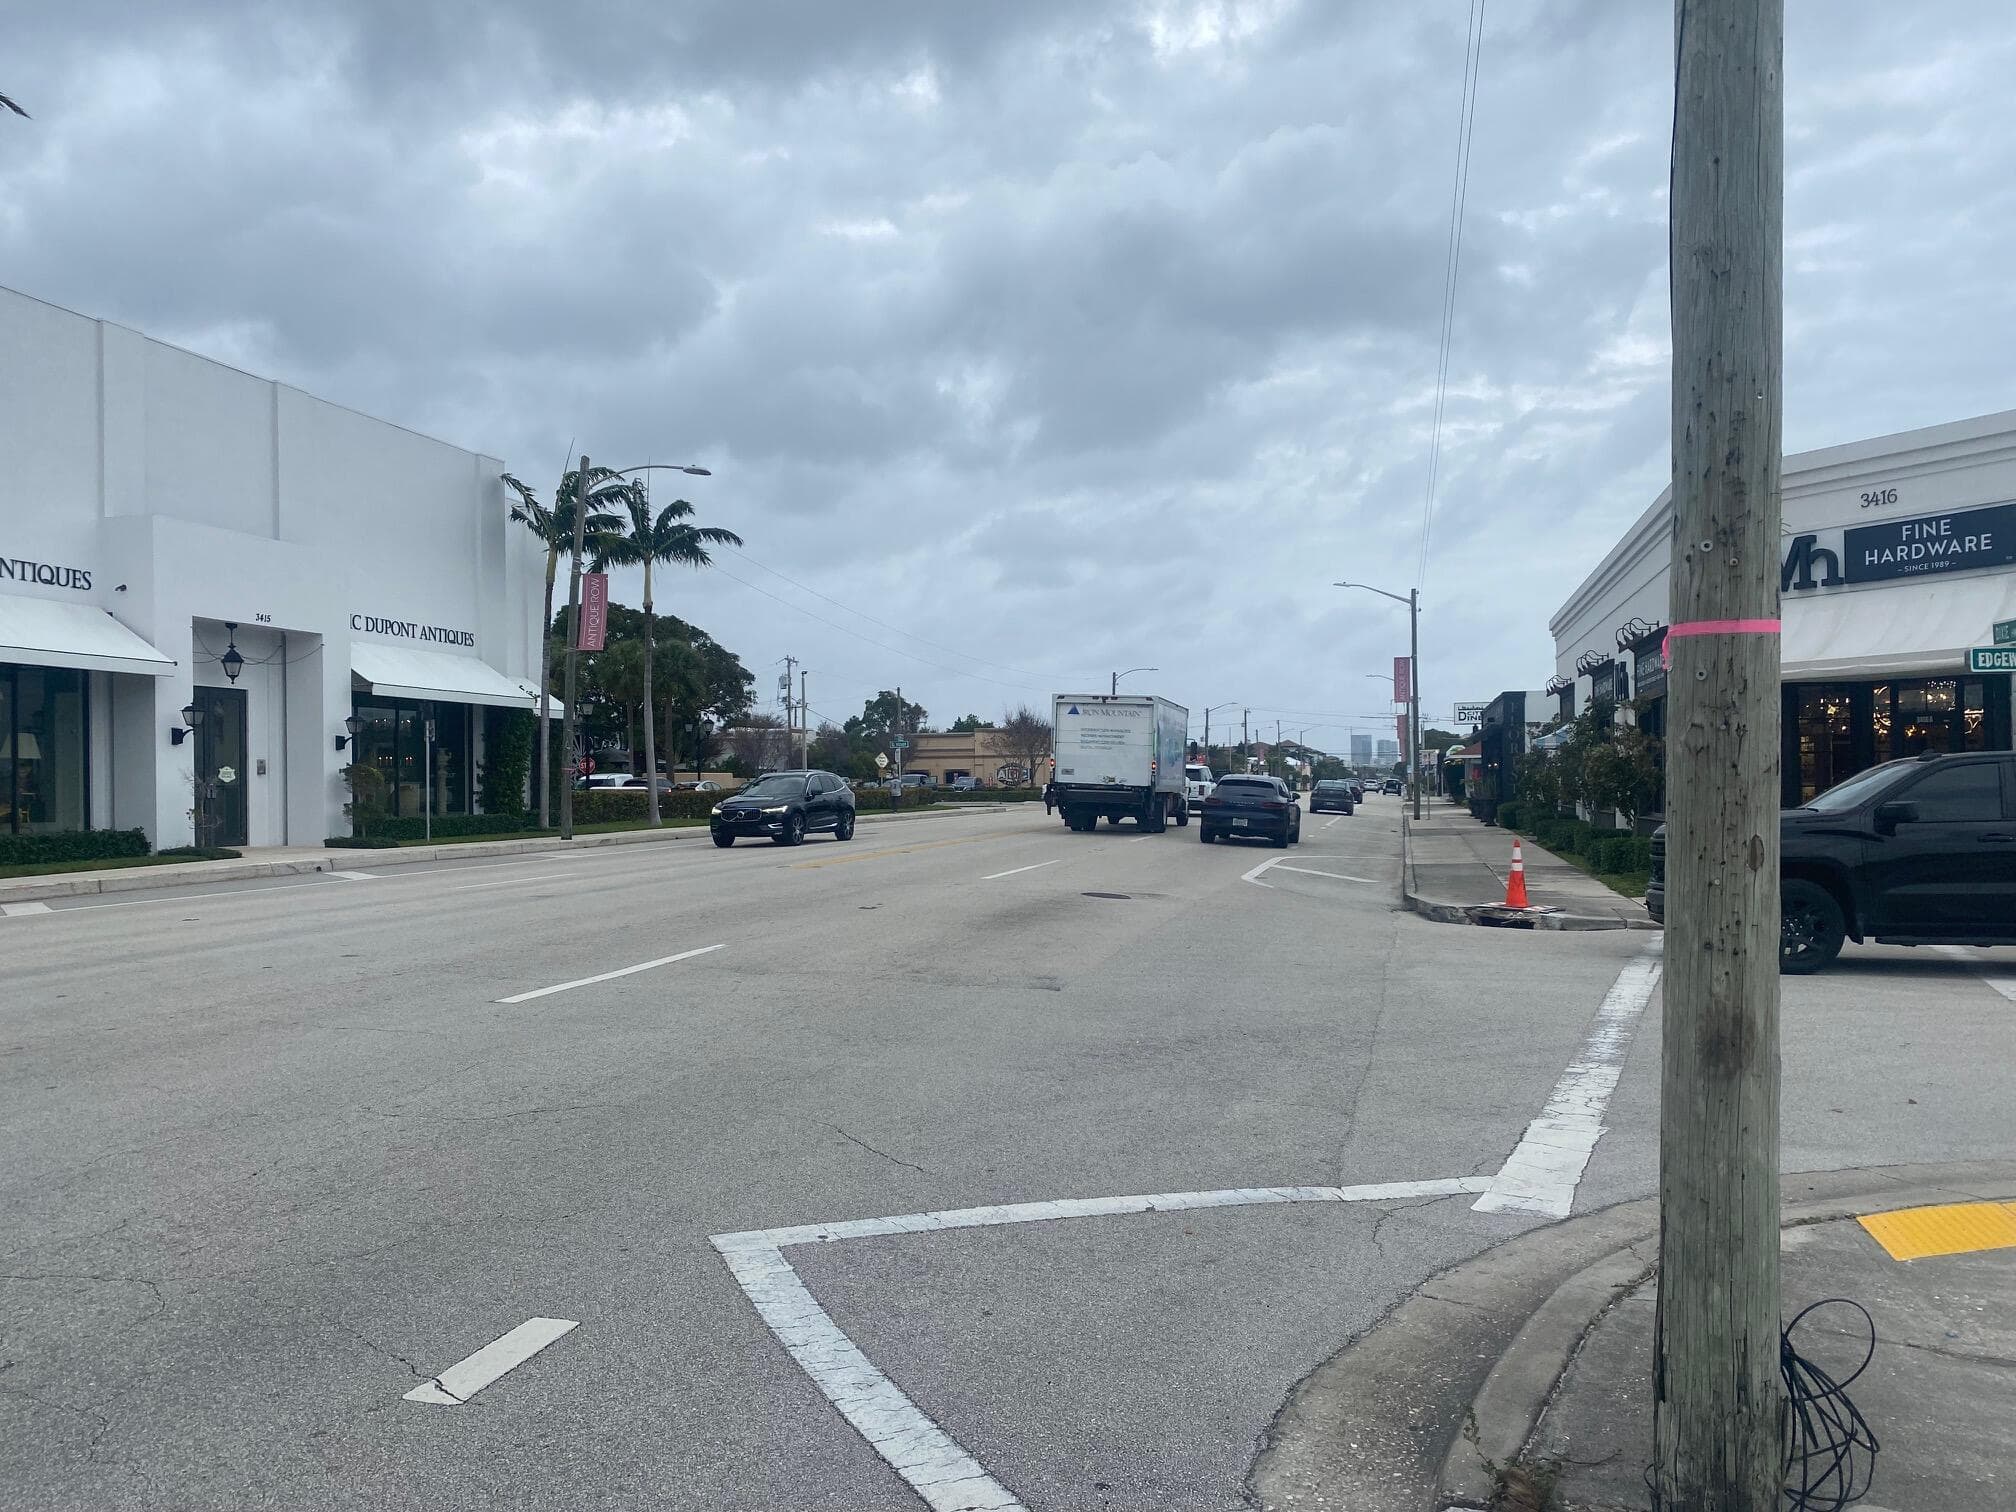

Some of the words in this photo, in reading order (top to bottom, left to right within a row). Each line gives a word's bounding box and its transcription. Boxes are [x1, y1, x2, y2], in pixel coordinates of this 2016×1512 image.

[1860, 488, 1898, 508] 3416
[1901, 518, 1952, 541] FINE
[1864, 533, 1993, 566] HARDWARE
[0, 557, 92, 591] NTIQUES
[1904, 563, 1929, 573] SINCE
[1931, 561, 1950, 569] 1989
[590, 577, 600, 603] ROW
[255, 613, 272, 623] 3415
[587, 605, 599, 647] ANTIQUE
[364, 616, 418, 639] DUPONT
[419, 625, 474, 647] ANTIQUES
